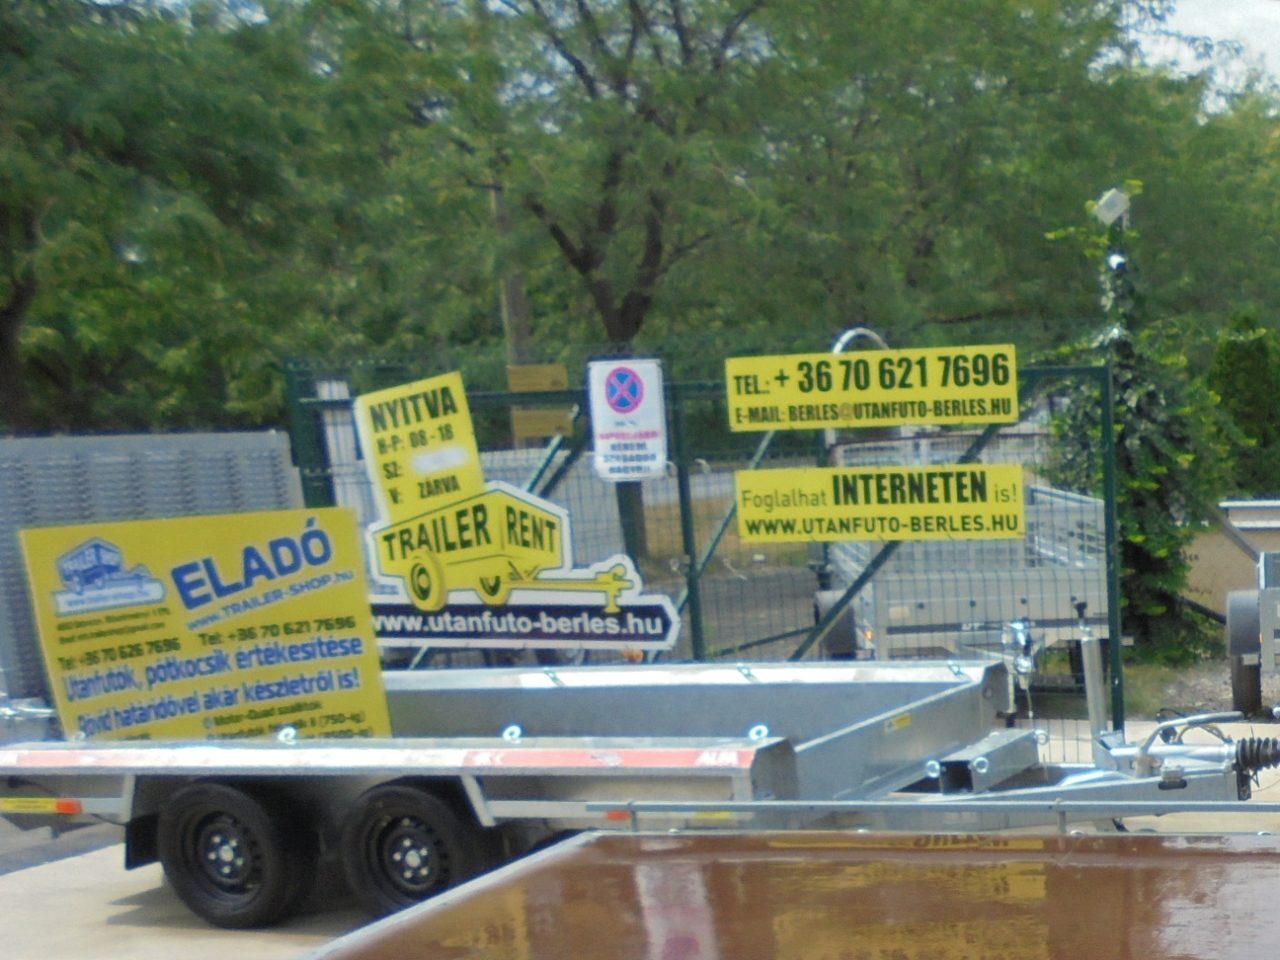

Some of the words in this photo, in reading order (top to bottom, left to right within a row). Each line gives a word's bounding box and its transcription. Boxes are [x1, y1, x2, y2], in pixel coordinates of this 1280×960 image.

[734, 374, 771, 395] TEL.:
[774, 368, 790, 388] +
[797, 360, 833, 393] 36
[839, 358, 871, 392] 70
[878, 356, 928, 390] 621
[937, 353, 1010, 388] 7696
[369, 386, 458, 433] NYITVA
[735, 405, 785, 424] E-MAIL:
[787, 397, 1012, 423] BERLES@UTANFUTO-BERLES.HU
[741, 488, 828, 513] Foglalhat
[832, 470, 988, 506] INTERNETEN
[993, 483, 1017, 503] is!
[382, 503, 492, 561] TRAILER
[505, 505, 557, 553] RENT
[745, 514, 1019, 536] WWW.UTANFUTO-BERLES.HU
[170, 516, 332, 610] ELADÓ
[259, 624, 280, 638] 70
[283, 620, 311, 636] 621
[314, 615, 356, 632] 7696
